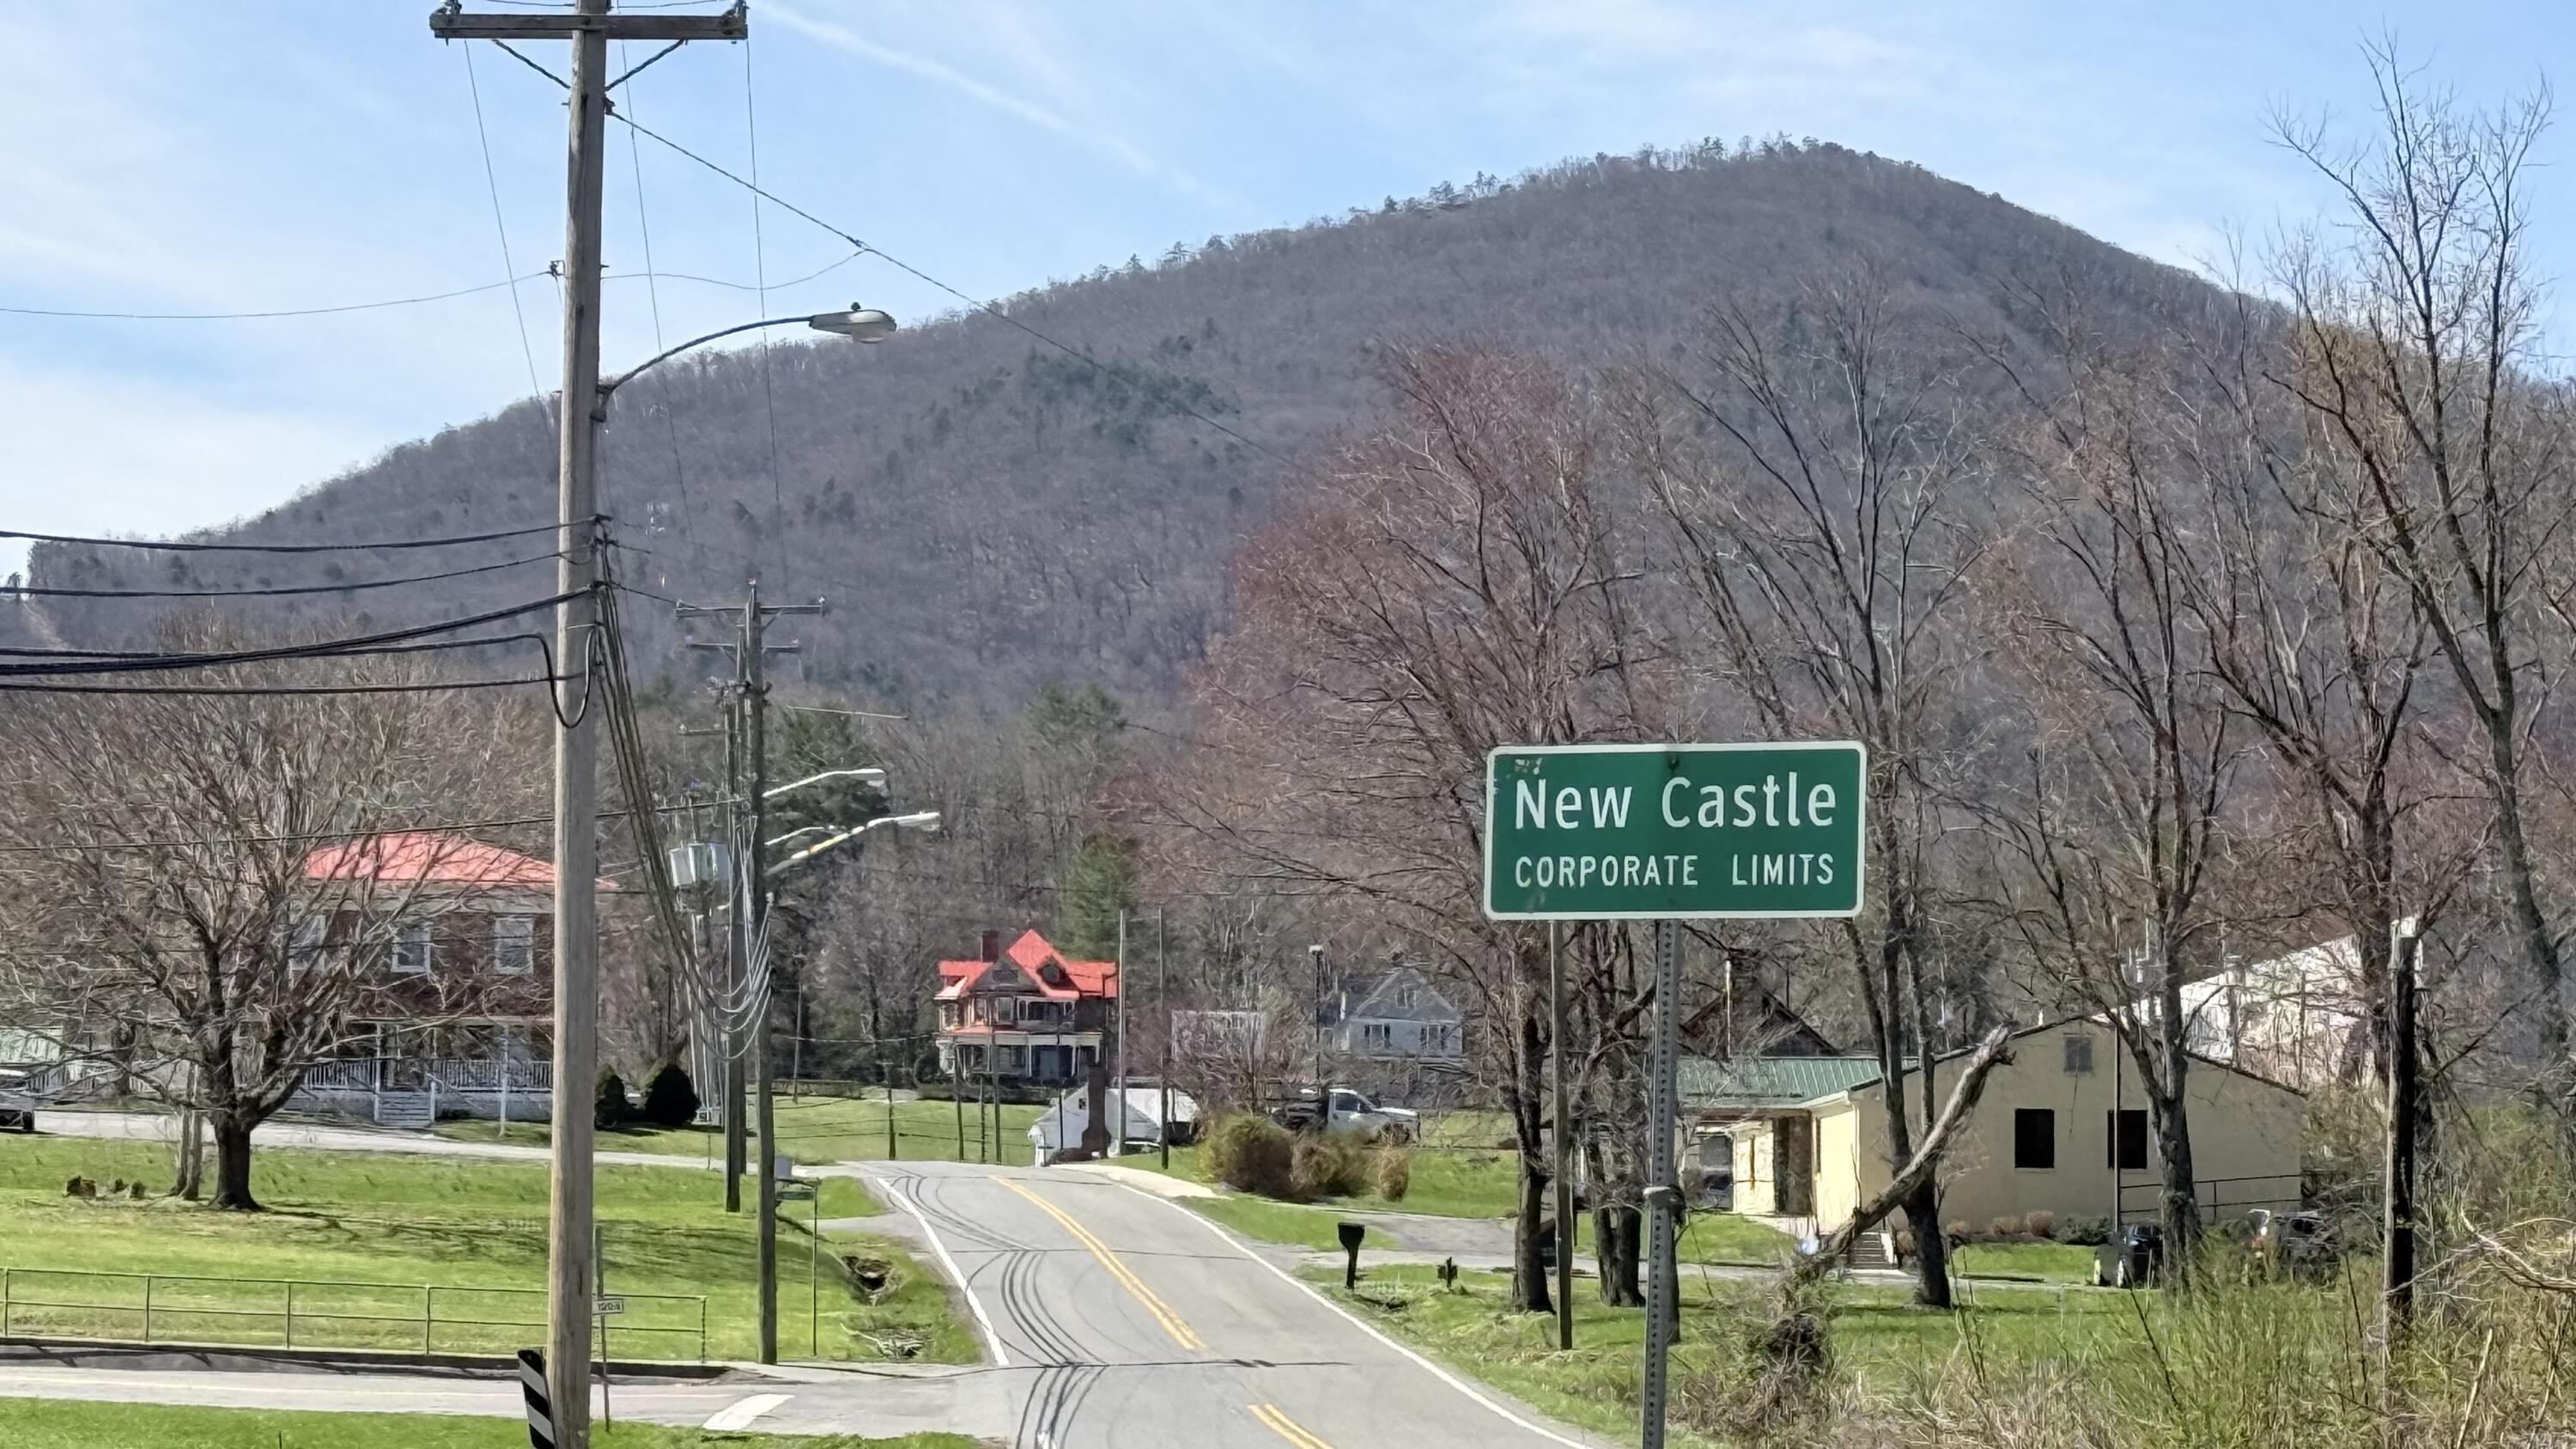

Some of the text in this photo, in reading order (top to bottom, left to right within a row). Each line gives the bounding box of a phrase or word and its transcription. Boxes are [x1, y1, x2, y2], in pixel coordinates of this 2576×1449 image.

[1516, 771, 1837, 829] New Castle
[1515, 854, 1834, 888] CORPORATE LIMITS
